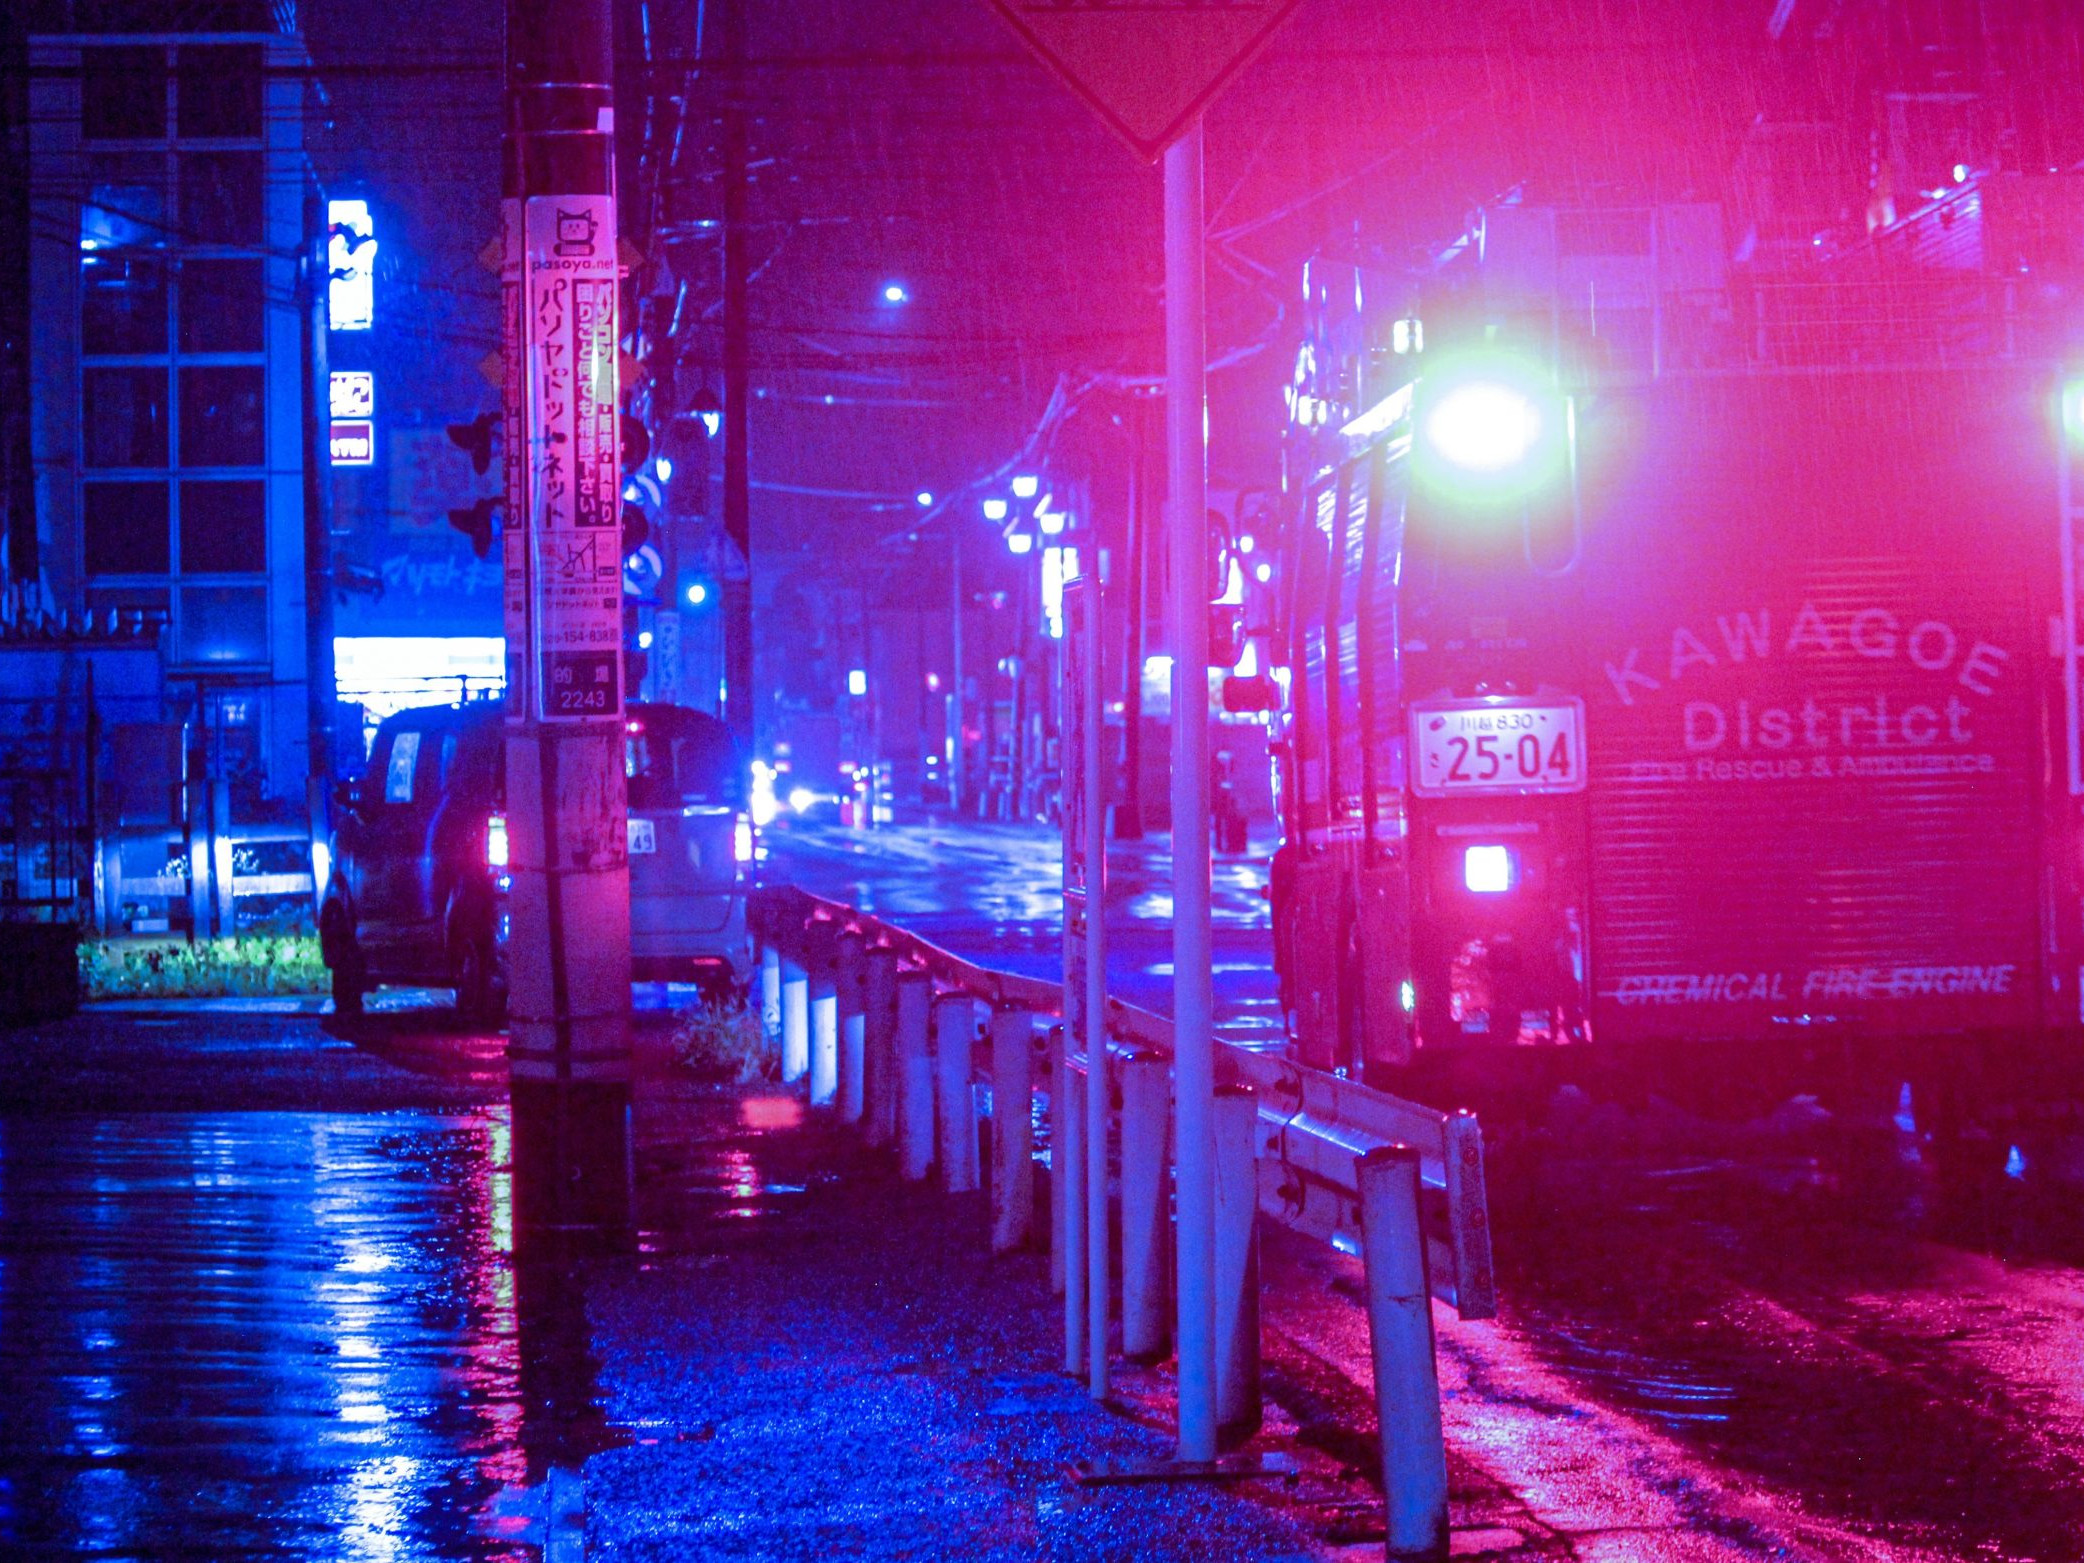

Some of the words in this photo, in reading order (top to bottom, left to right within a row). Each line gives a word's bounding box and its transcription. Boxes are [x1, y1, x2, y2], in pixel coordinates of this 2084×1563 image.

[531, 258, 614, 273] pasoya.net
[539, 278, 569, 528] パソヤドットネット
[1604, 605, 2009, 706] KAWAGOE
[560, 690, 606, 709] 2243
[1497, 713, 1534, 730] 830
[1684, 696, 1973, 751] District
[1448, 732, 1570, 781] 25-04
[1696, 756, 1803, 781] Rescue
[1810, 755, 1833, 777] &
[1616, 972, 1788, 1005] CHEMICAL
[1802, 968, 1879, 999] FIRE
[1891, 964, 2017, 998] ENGINE
